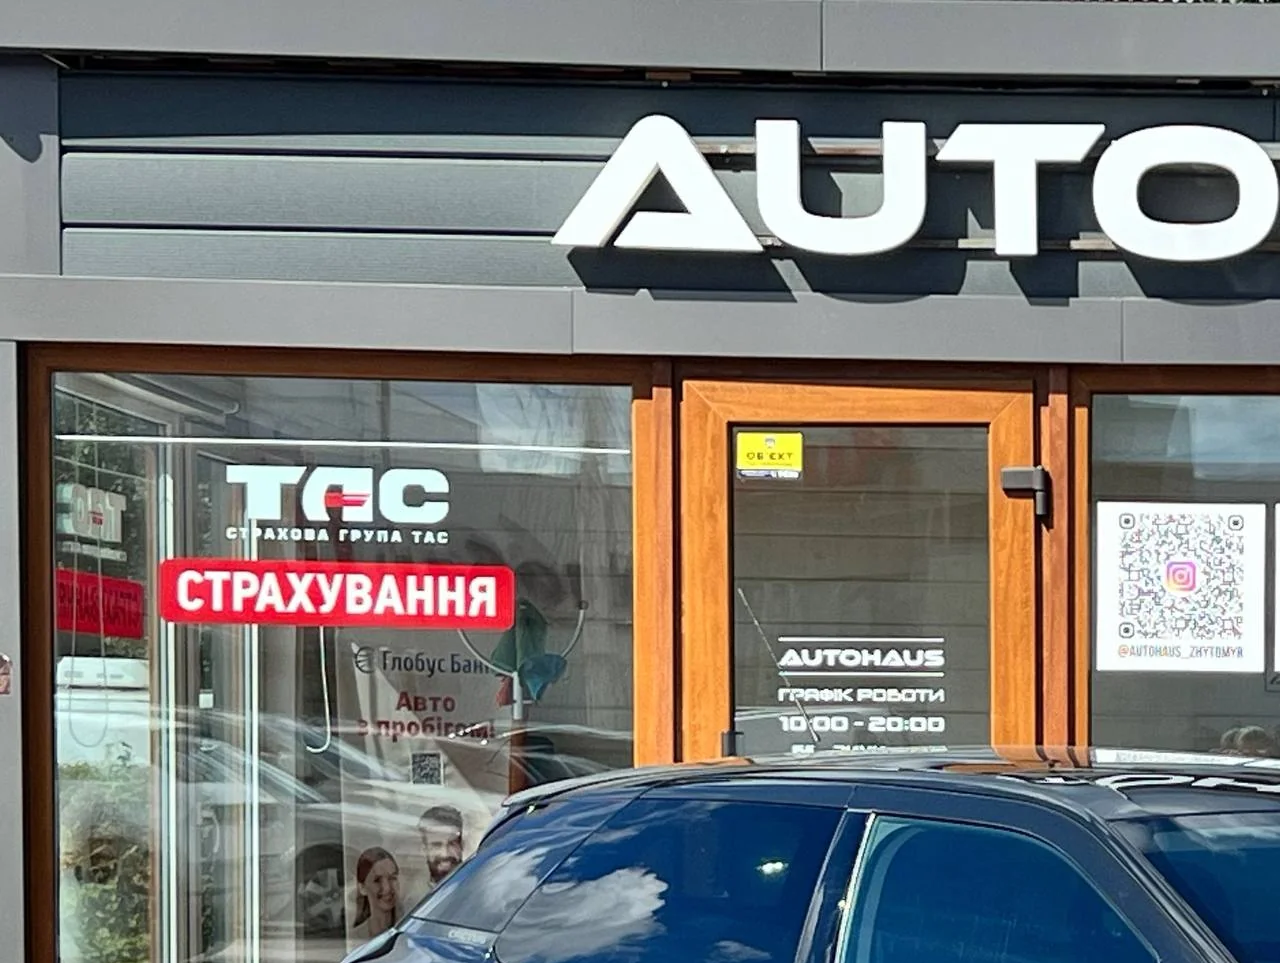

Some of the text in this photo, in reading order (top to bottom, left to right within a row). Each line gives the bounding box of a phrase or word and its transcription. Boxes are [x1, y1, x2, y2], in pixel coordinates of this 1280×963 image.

[226, 527, 449, 544] СТРАХОВА ГРУПА ТАС
[176, 570, 497, 618] СТРАХУВАННЯ
[383, 651, 445, 677] Глобус
[778, 649, 945, 667] AUTOHAUS
[396, 691, 456, 712] Авто
[778, 688, 945, 702] ГРАФІК РОБОТИ
[778, 716, 849, 732] 10:00
[868, 716, 945, 732] 20:00
